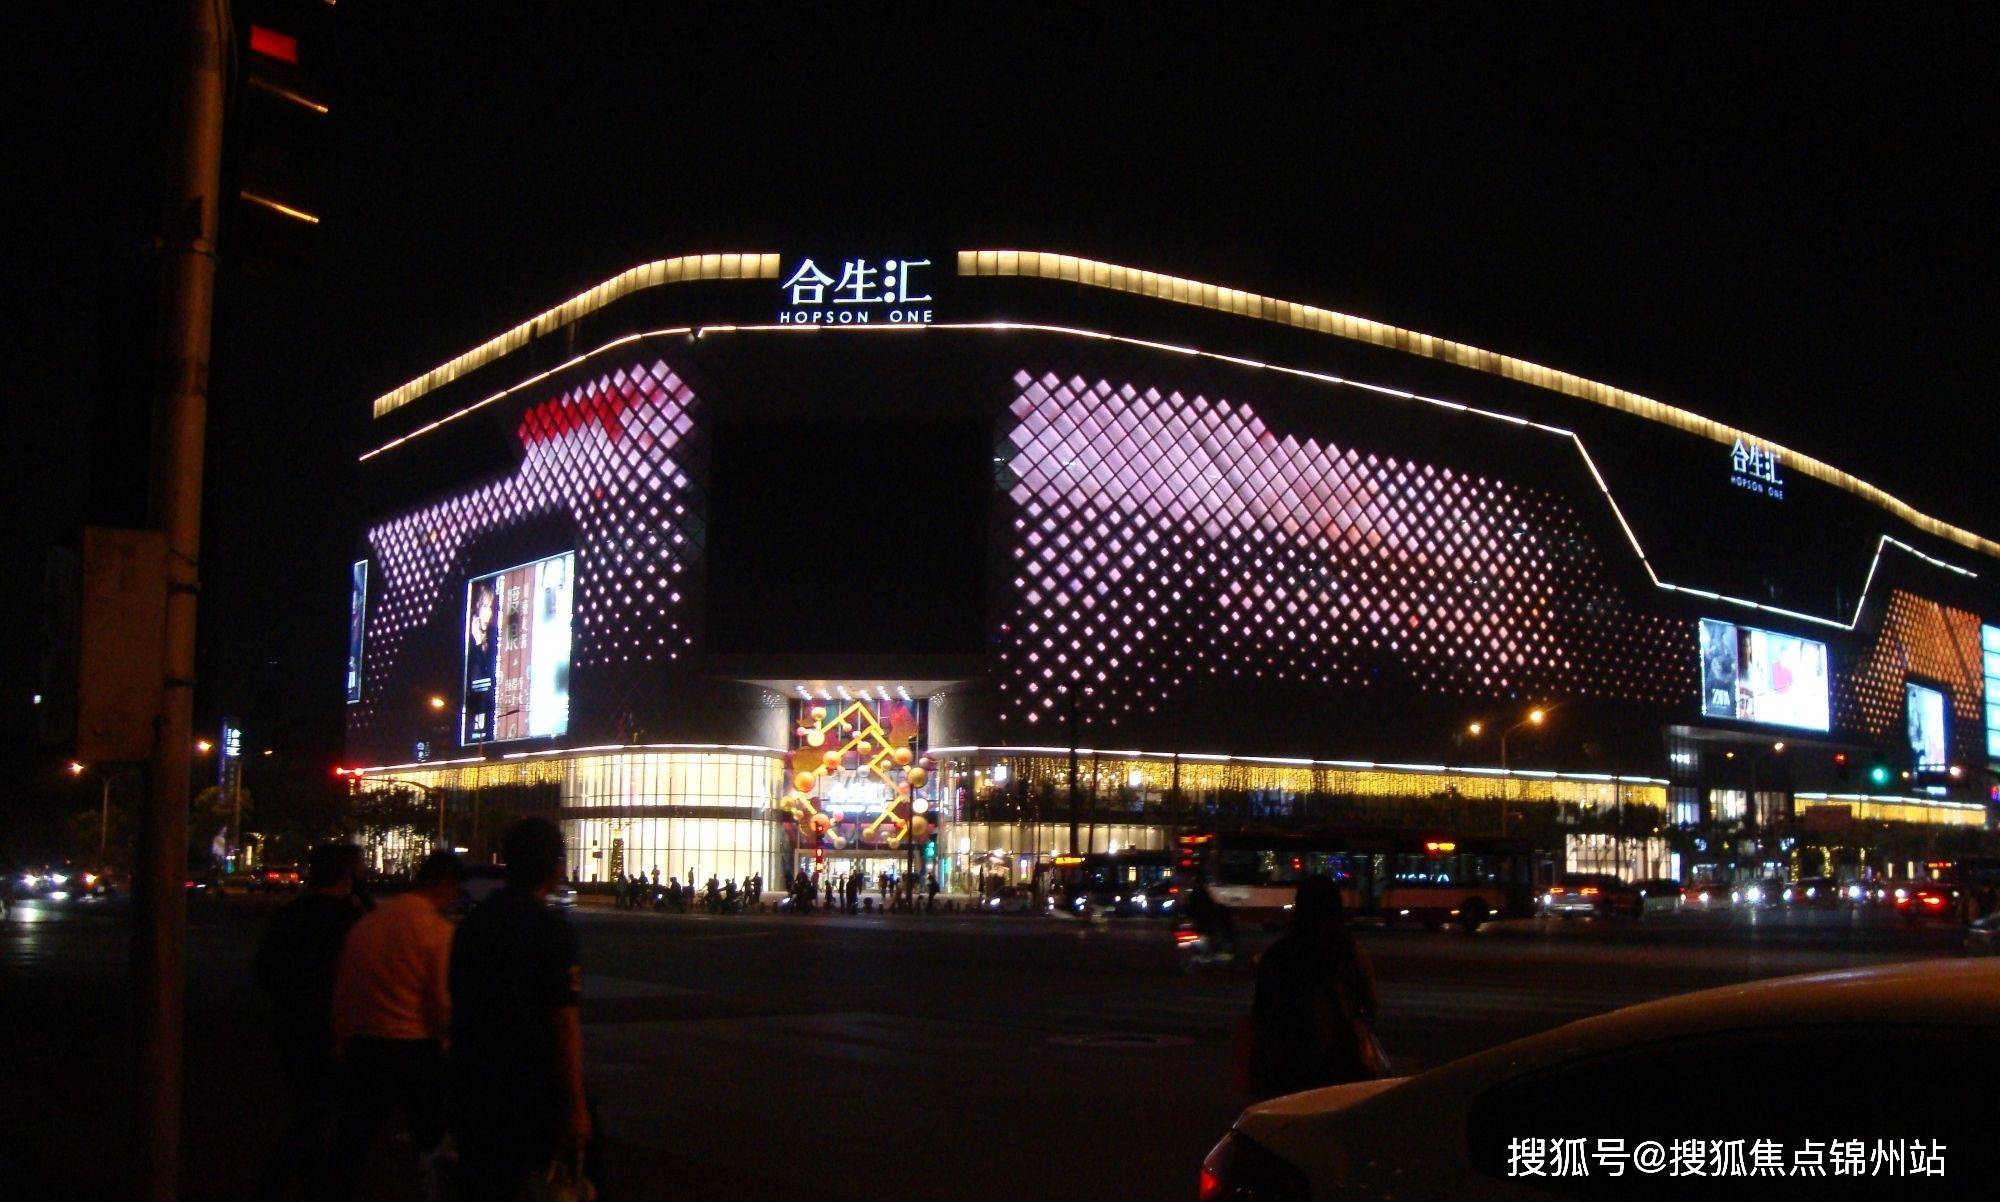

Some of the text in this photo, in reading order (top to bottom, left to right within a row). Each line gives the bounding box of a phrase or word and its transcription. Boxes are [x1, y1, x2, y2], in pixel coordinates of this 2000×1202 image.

[782, 259, 932, 304] 合生汇
[781, 310, 932, 323] HOPSON ONE
[1730, 439, 1783, 484] 合生汇
[1731, 475, 1783, 500] HOPSON ONE
